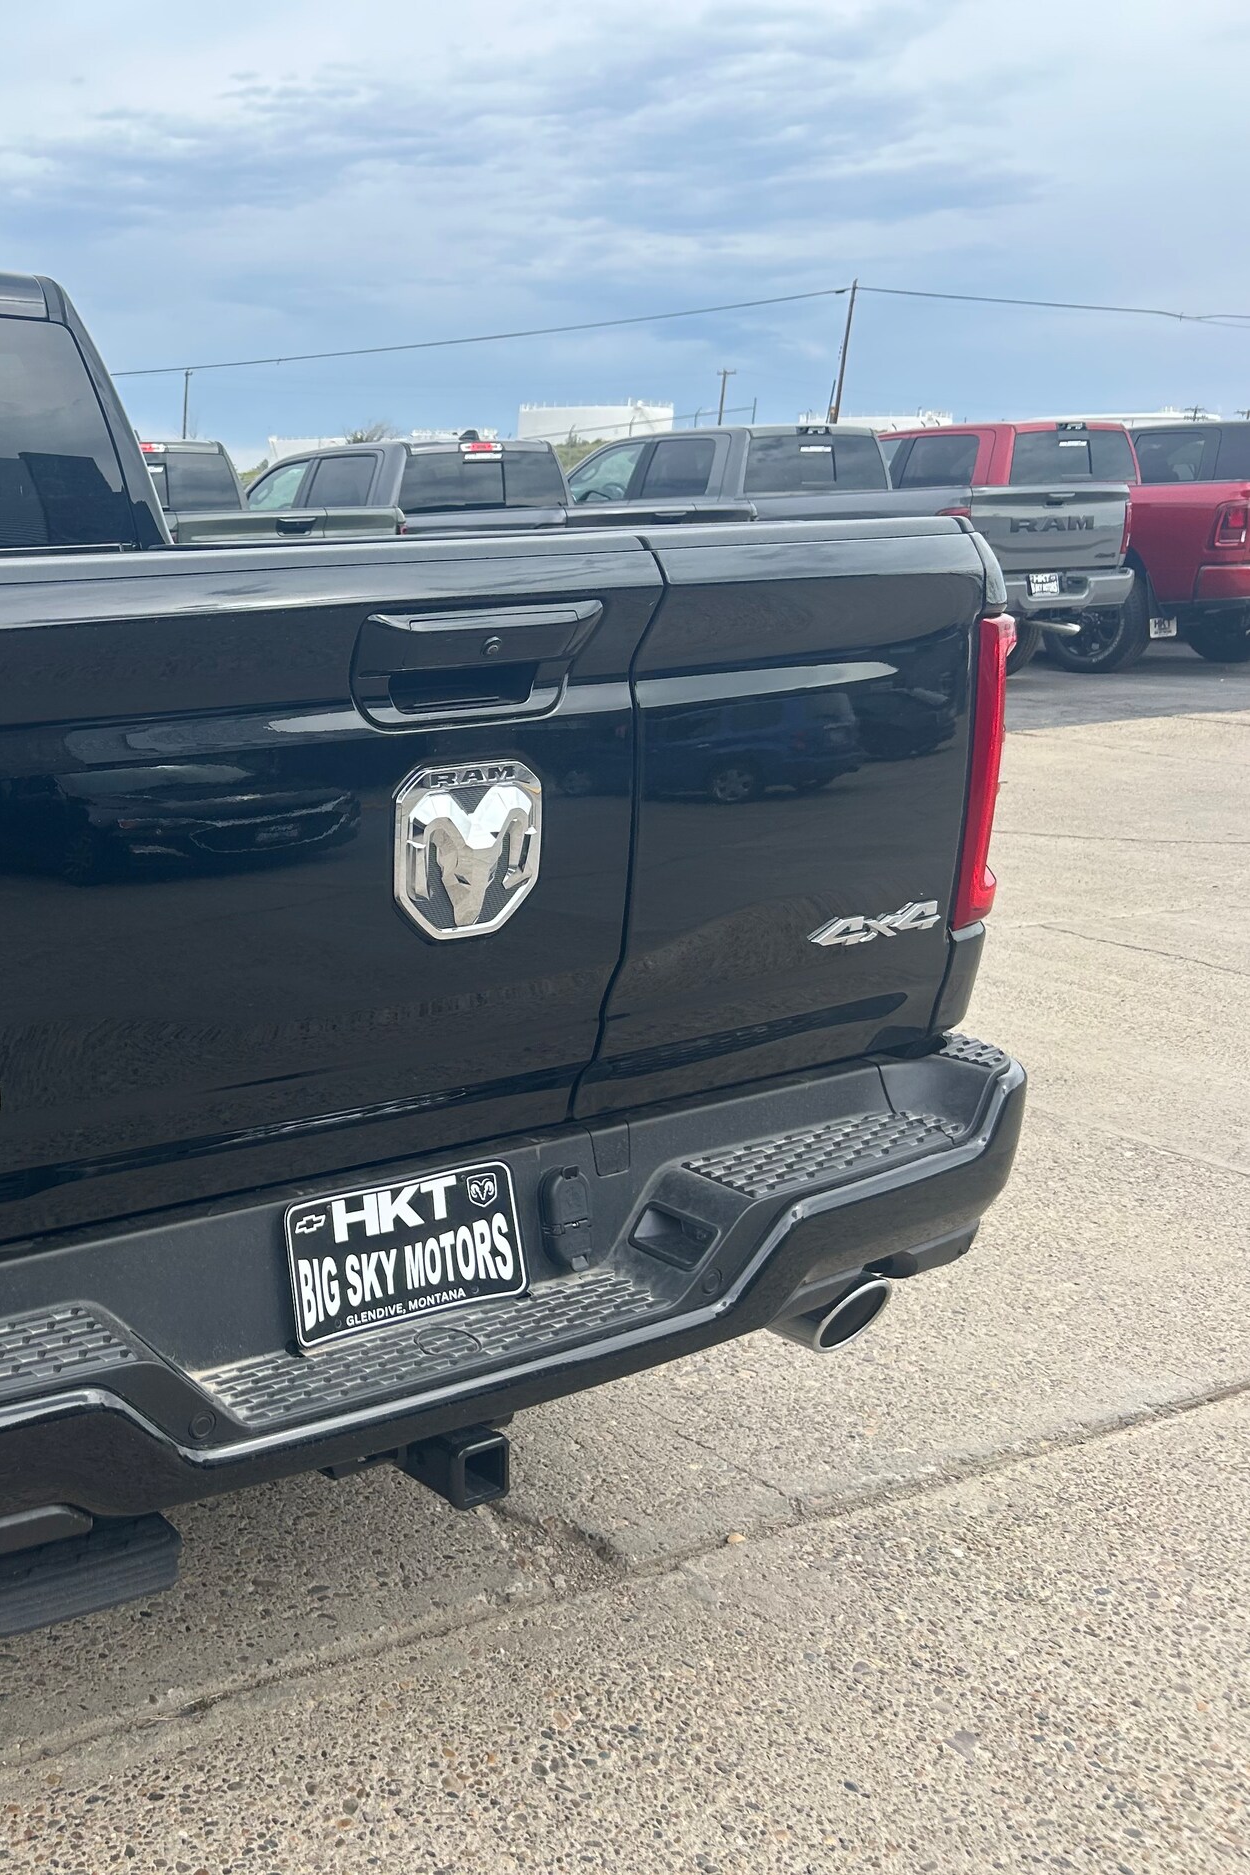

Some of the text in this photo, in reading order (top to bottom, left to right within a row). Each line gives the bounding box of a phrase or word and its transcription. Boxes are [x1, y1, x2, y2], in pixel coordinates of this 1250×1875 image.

[1009, 515, 1095, 533] RAM
[430, 765, 516, 788] RAM
[331, 1174, 457, 1244] HKT
[298, 1212, 514, 1332] BIG SKY MOTORS
[345, 1287, 467, 1327] GLENDIVE, MONTANA
